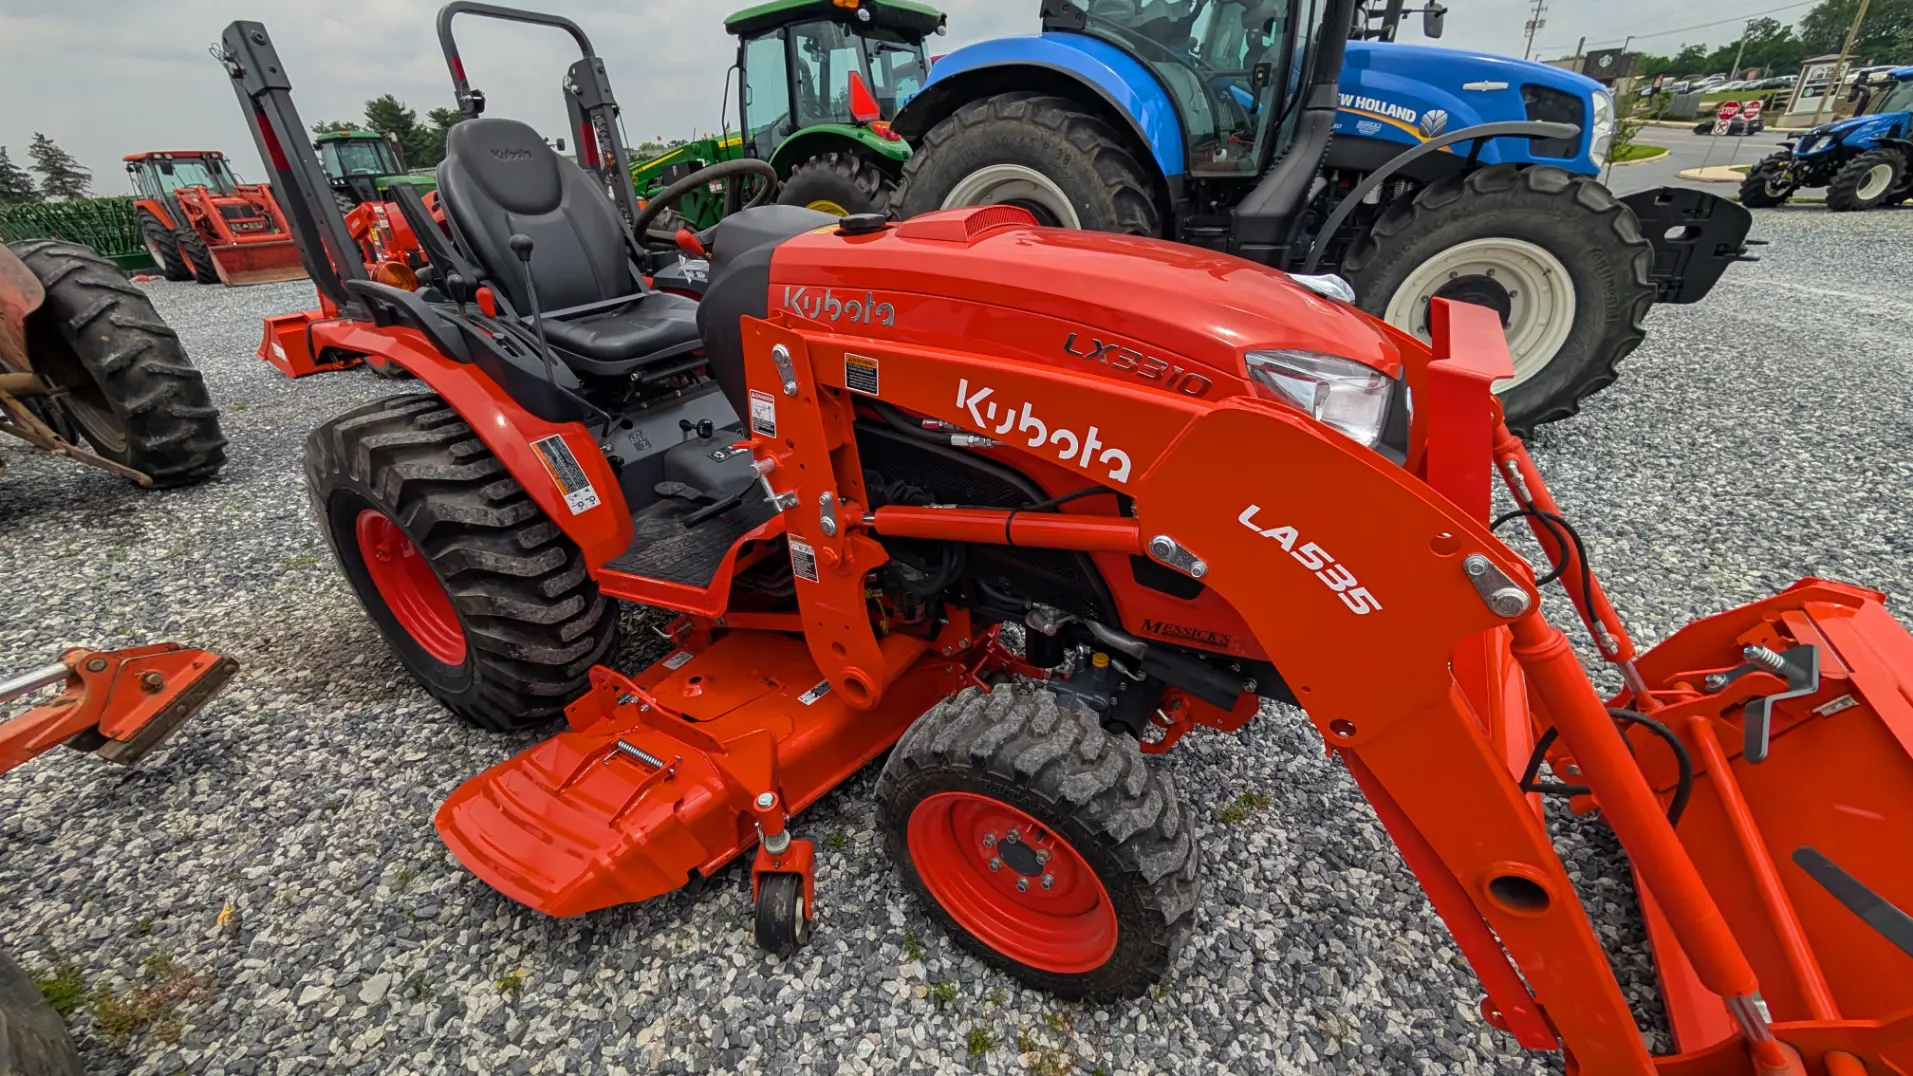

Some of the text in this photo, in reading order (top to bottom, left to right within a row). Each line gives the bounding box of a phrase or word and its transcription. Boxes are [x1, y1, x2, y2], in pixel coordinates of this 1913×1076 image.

[1355, 96, 1417, 123] HOLLAND
[1719, 105, 1740, 115] STOP
[489, 148, 534, 160] Kubota
[783, 286, 895, 327] Kubota
[1063, 332, 1213, 397] LX3310
[956, 378, 1132, 484] Kubota
[1237, 503, 1383, 615] LA535
